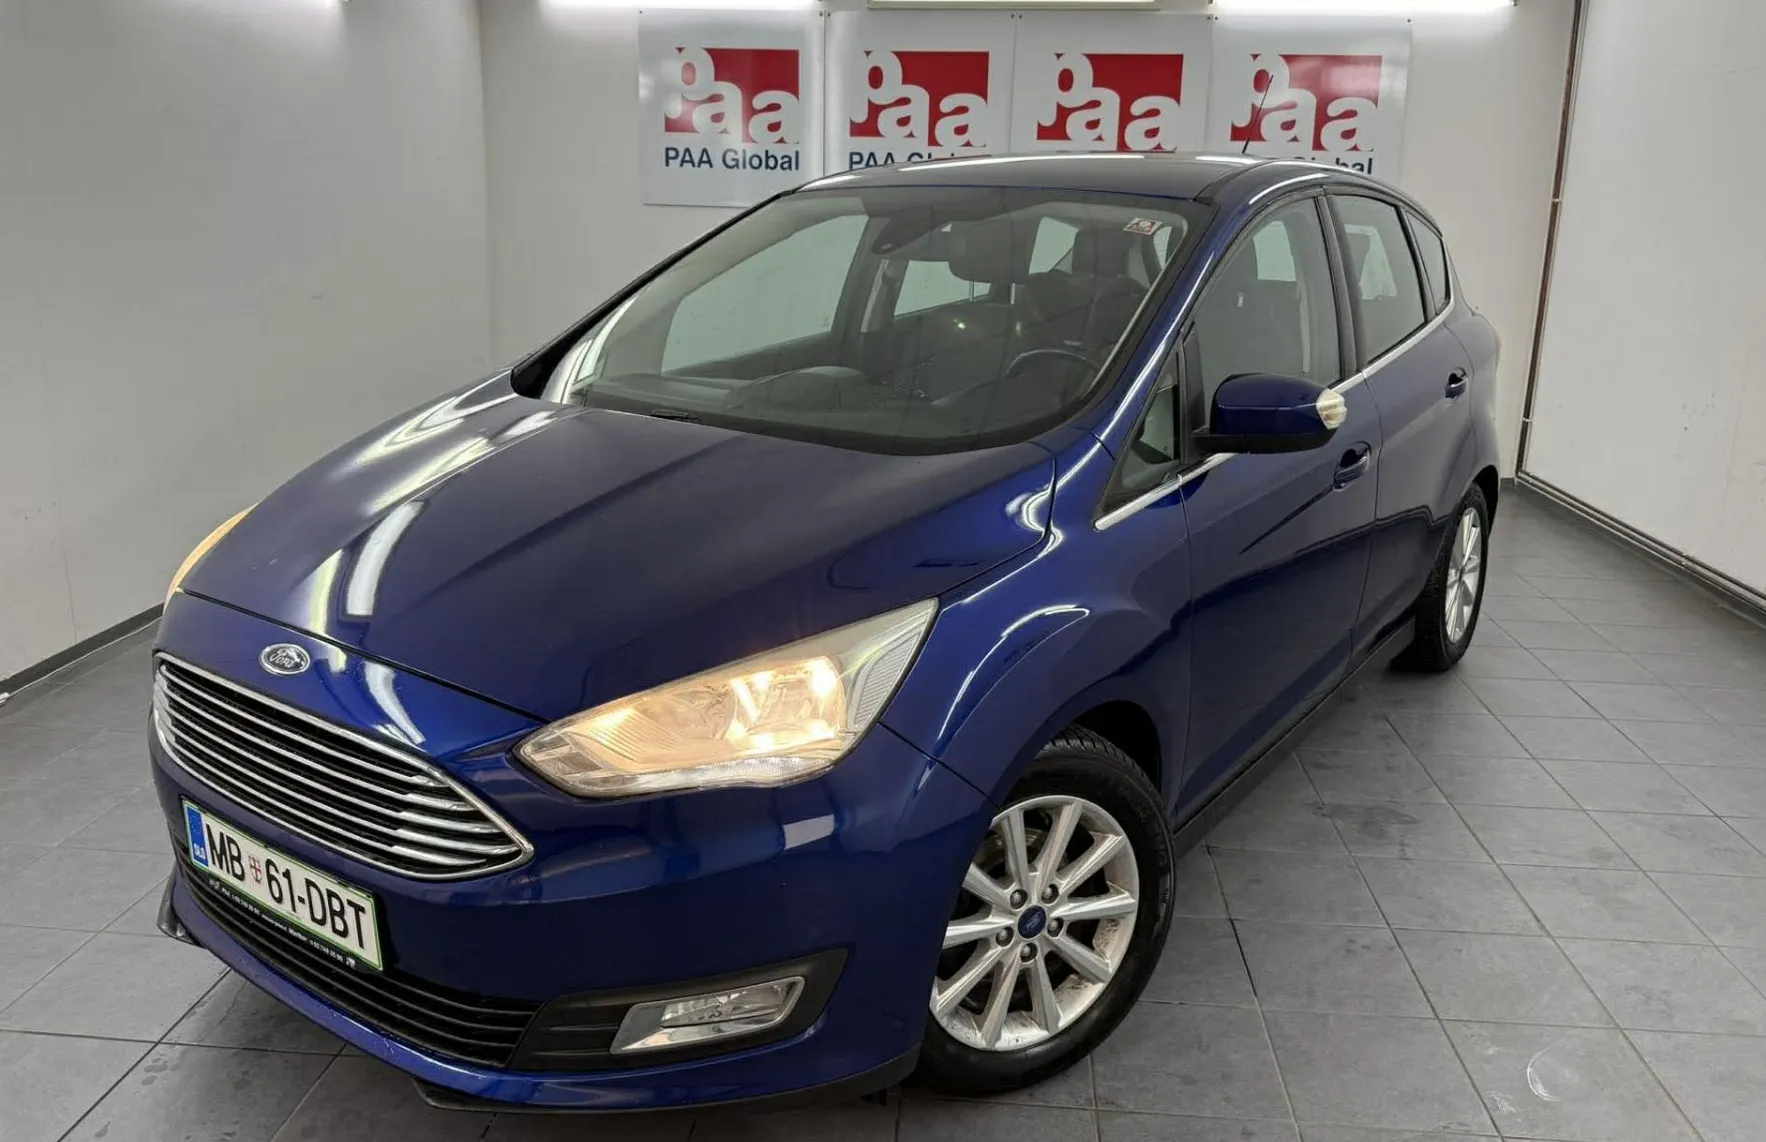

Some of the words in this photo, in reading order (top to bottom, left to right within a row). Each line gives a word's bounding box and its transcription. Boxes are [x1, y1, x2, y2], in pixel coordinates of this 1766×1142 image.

[664, 146, 713, 168] PAA
[721, 148, 800, 171] Global
[205, 823, 245, 881] MB
[265, 858, 366, 950] 61-DBT
